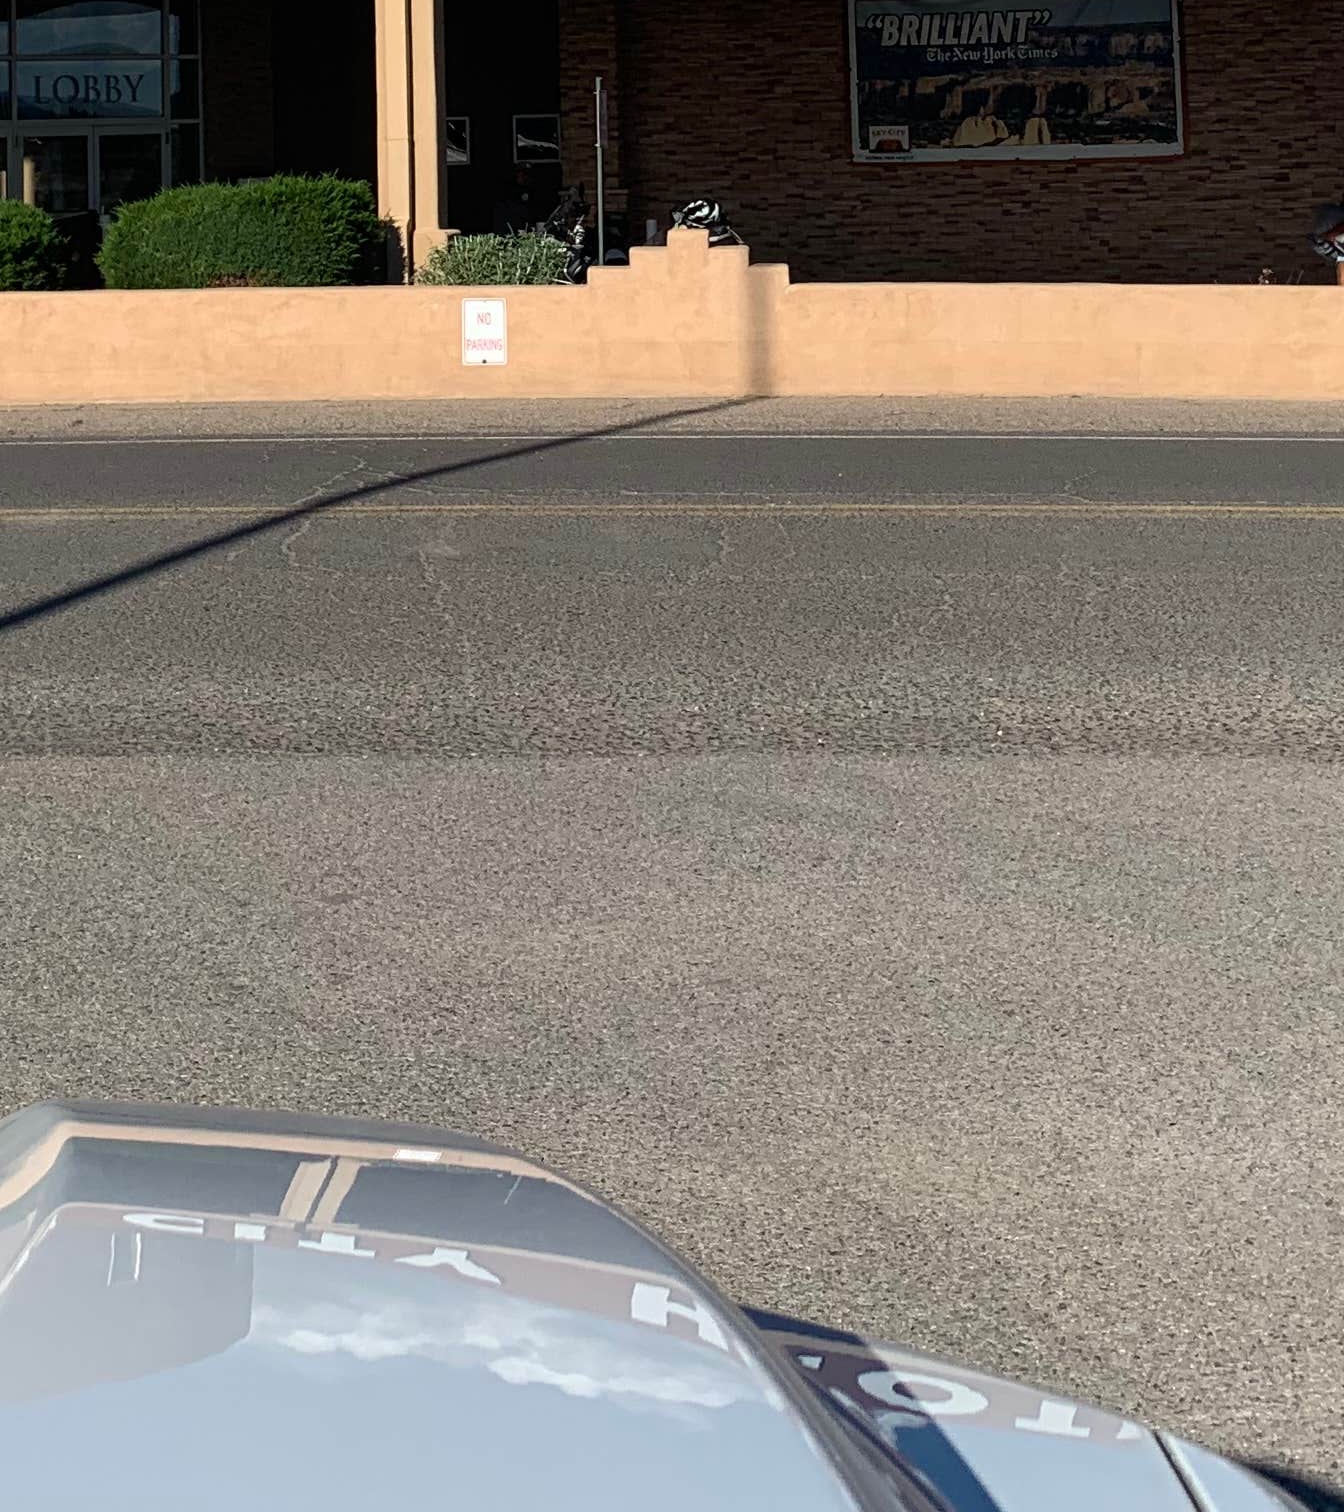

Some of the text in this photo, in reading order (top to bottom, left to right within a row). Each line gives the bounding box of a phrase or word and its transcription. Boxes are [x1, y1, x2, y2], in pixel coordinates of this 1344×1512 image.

[926, 44, 1059, 64] The New York Times
[33, 73, 145, 105] LOBBY
[476, 311, 492, 326] NO
[466, 338, 503, 351] PARKING
